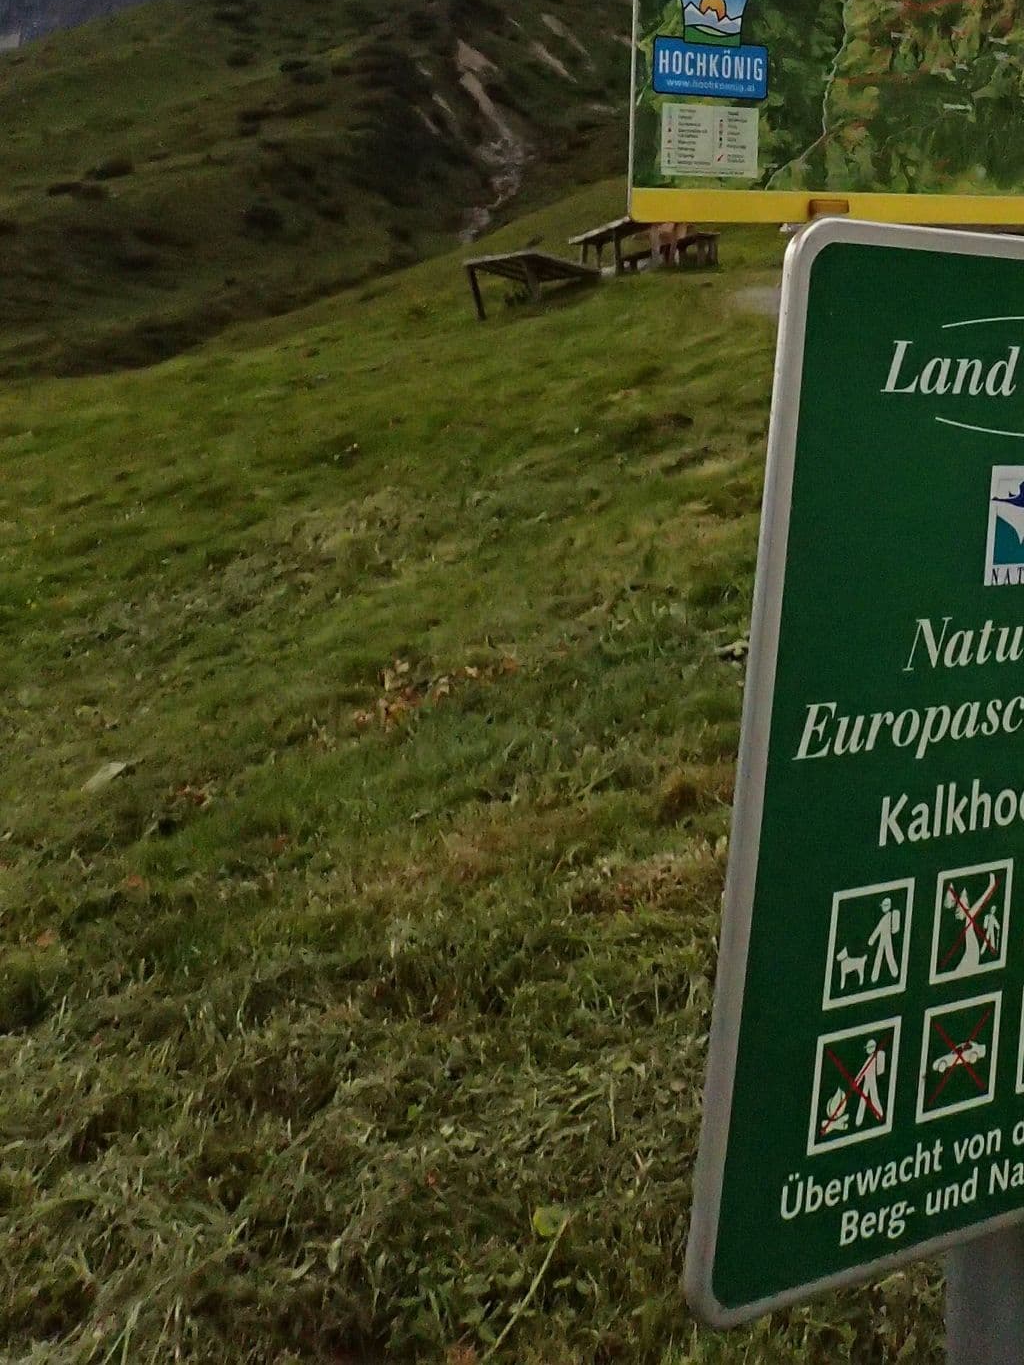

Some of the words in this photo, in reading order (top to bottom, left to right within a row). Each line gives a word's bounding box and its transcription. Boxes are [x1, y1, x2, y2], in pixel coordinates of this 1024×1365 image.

[658, 49, 763, 81] HOCHKÖNIG
[880, 340, 1020, 397] Land
[780, 1138, 943, 1220] Überwacht
[954, 1129, 1001, 1161] von
[839, 1198, 916, 1247] Berg-
[925, 1167, 978, 1217] und
